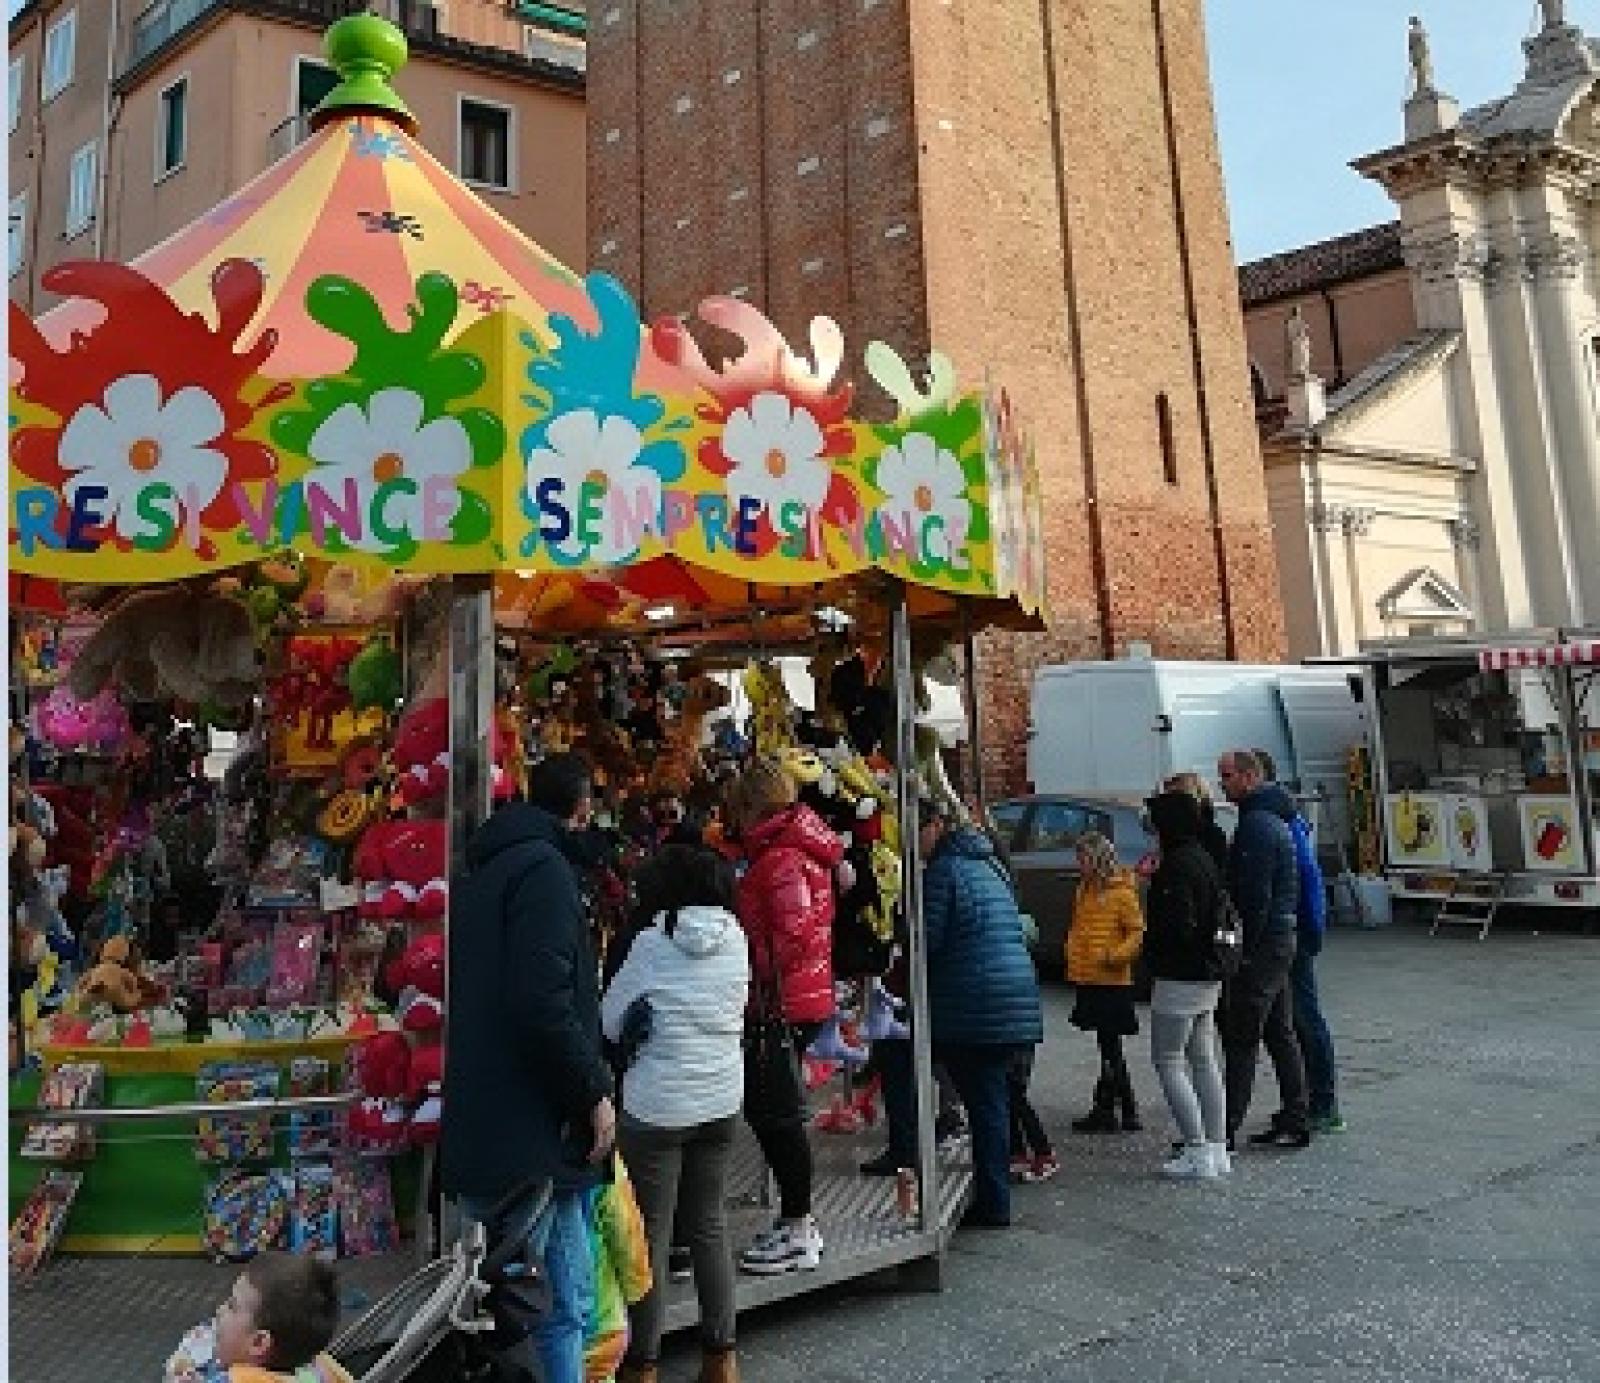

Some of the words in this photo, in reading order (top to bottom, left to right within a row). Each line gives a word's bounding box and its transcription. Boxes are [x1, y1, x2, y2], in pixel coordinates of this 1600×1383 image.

[133, 482, 200, 552] SI
[232, 474, 457, 549] VINCE
[536, 477, 762, 554] SEMPRE
[780, 502, 822, 560] SI
[833, 506, 969, 570] VINCE
